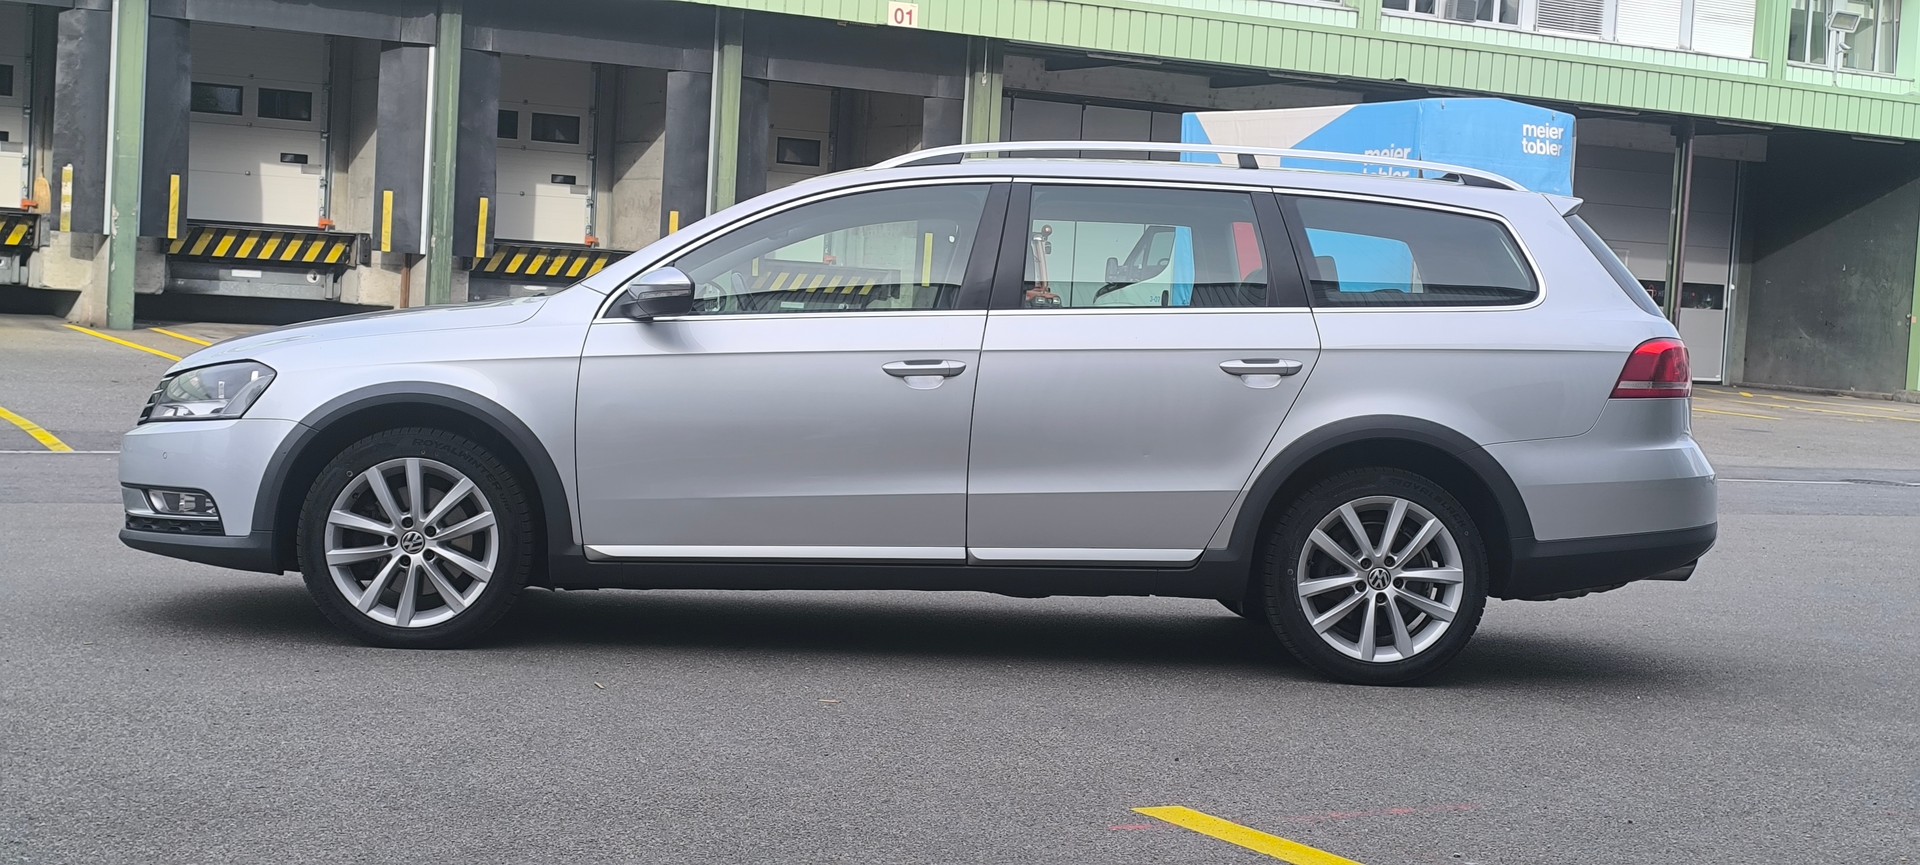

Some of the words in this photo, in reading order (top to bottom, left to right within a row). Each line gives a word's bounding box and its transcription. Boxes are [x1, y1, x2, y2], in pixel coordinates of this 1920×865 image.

[894, 8, 913, 25] 01
[1522, 122, 1564, 140] meier
[1521, 137, 1563, 156] tobler
[412, 438, 503, 490] ROYALWINTER
